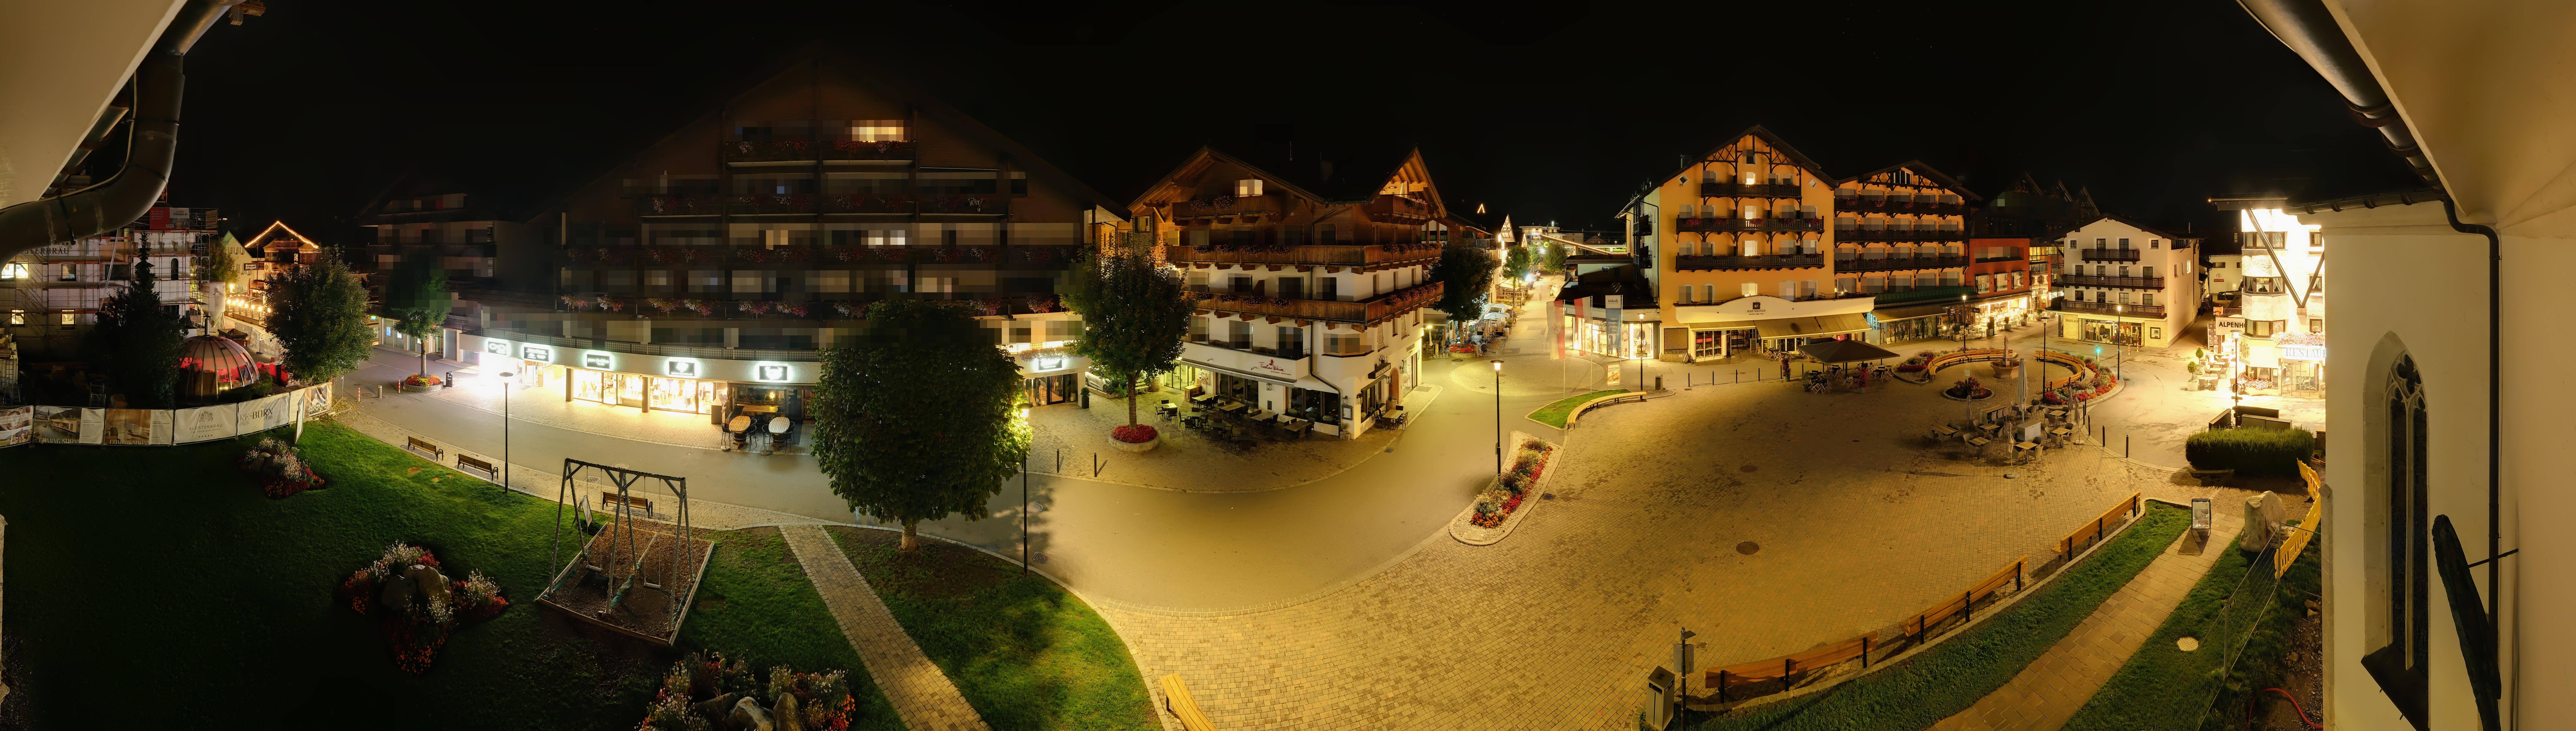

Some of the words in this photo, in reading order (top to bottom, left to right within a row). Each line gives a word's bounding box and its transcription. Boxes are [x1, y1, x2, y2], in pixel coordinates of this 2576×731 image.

[1406, 343, 1415, 352] SAILER
[2239, 356, 2250, 365] Kaltschmid
[1376, 364, 1390, 377] RESTAURANT
